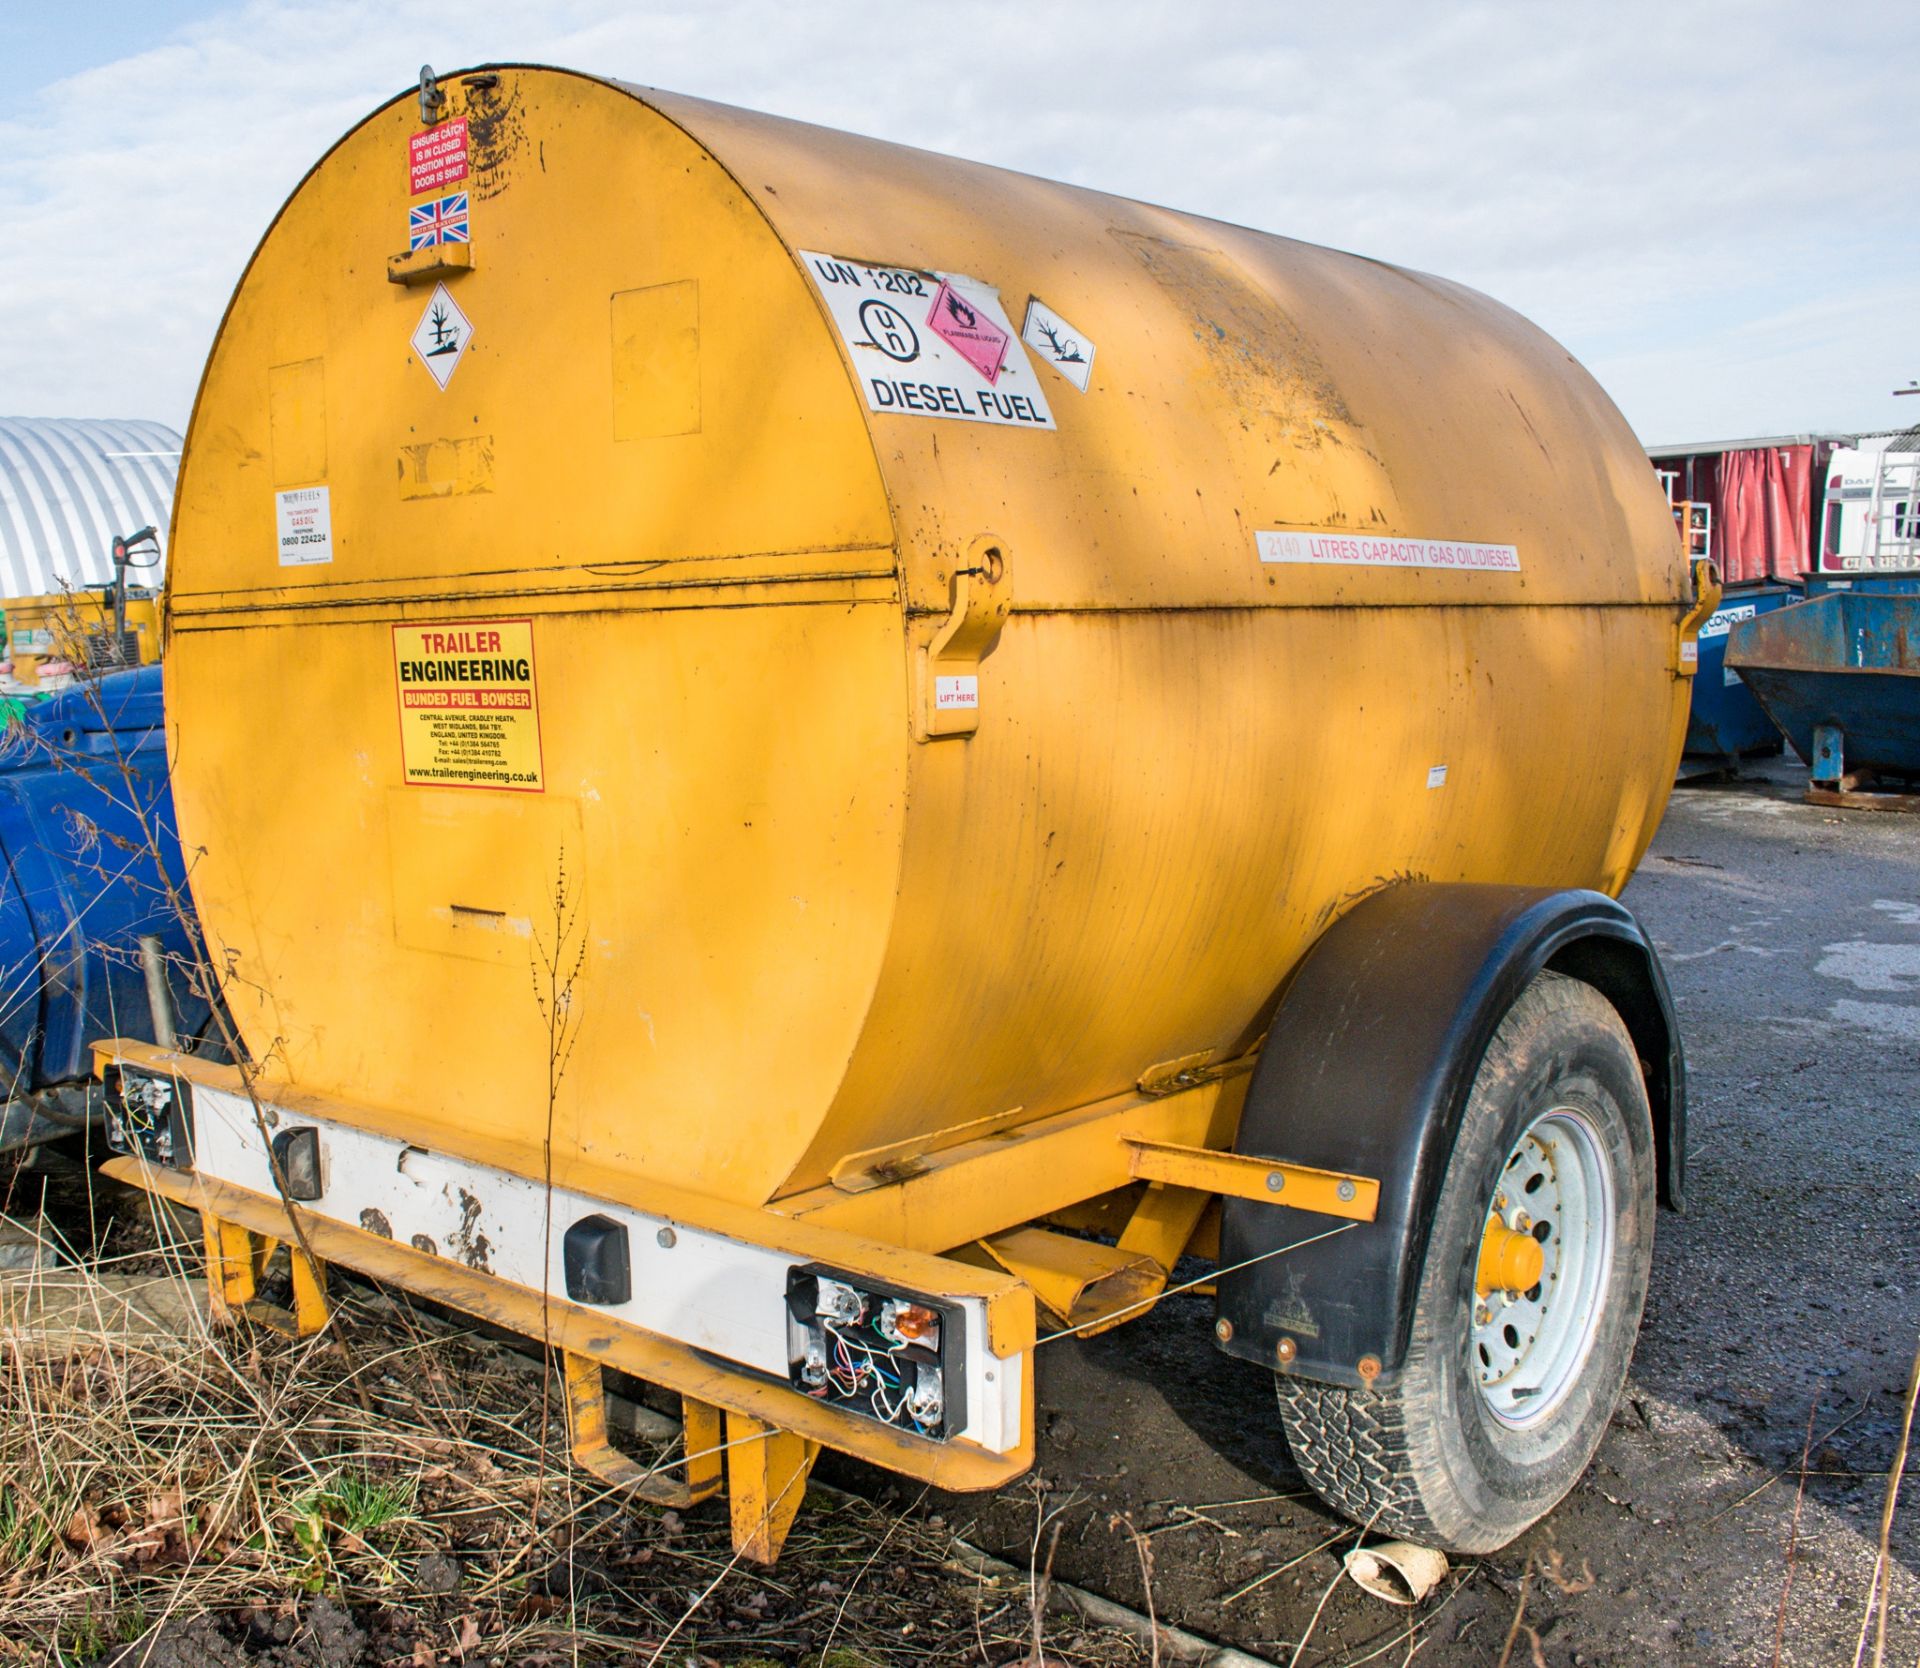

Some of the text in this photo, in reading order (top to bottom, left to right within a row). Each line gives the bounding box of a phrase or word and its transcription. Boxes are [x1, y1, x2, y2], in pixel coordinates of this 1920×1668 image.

[412, 123, 464, 150] ENSURE CATCH
[416, 138, 461, 162] IS IN CLOSED
[412, 151, 466, 176] POSITION WHEN
[415, 164, 464, 190] DOOR IS SHUT
[814, 260, 928, 297] UN 1202
[942, 329, 980, 341] FLAMMABLE
[871, 378, 1047, 423] DIESEL FUEL
[300, 490, 320, 502] FUELS
[292, 515, 314, 526] GAS OIL
[282, 534, 326, 546] 0800 224224
[1267, 536, 1518, 568] 2140 LITRES CAPACITY GAS OIL/DIESEL
[421, 632, 502, 654] TRAILER
[400, 658, 530, 682] ENGINEERING
[405, 692, 530, 707] BUNDED FUEL BOWSER
[940, 694, 975, 702] LIFT HERE
[409, 767, 538, 783] www.trailerengineering.co.uk
